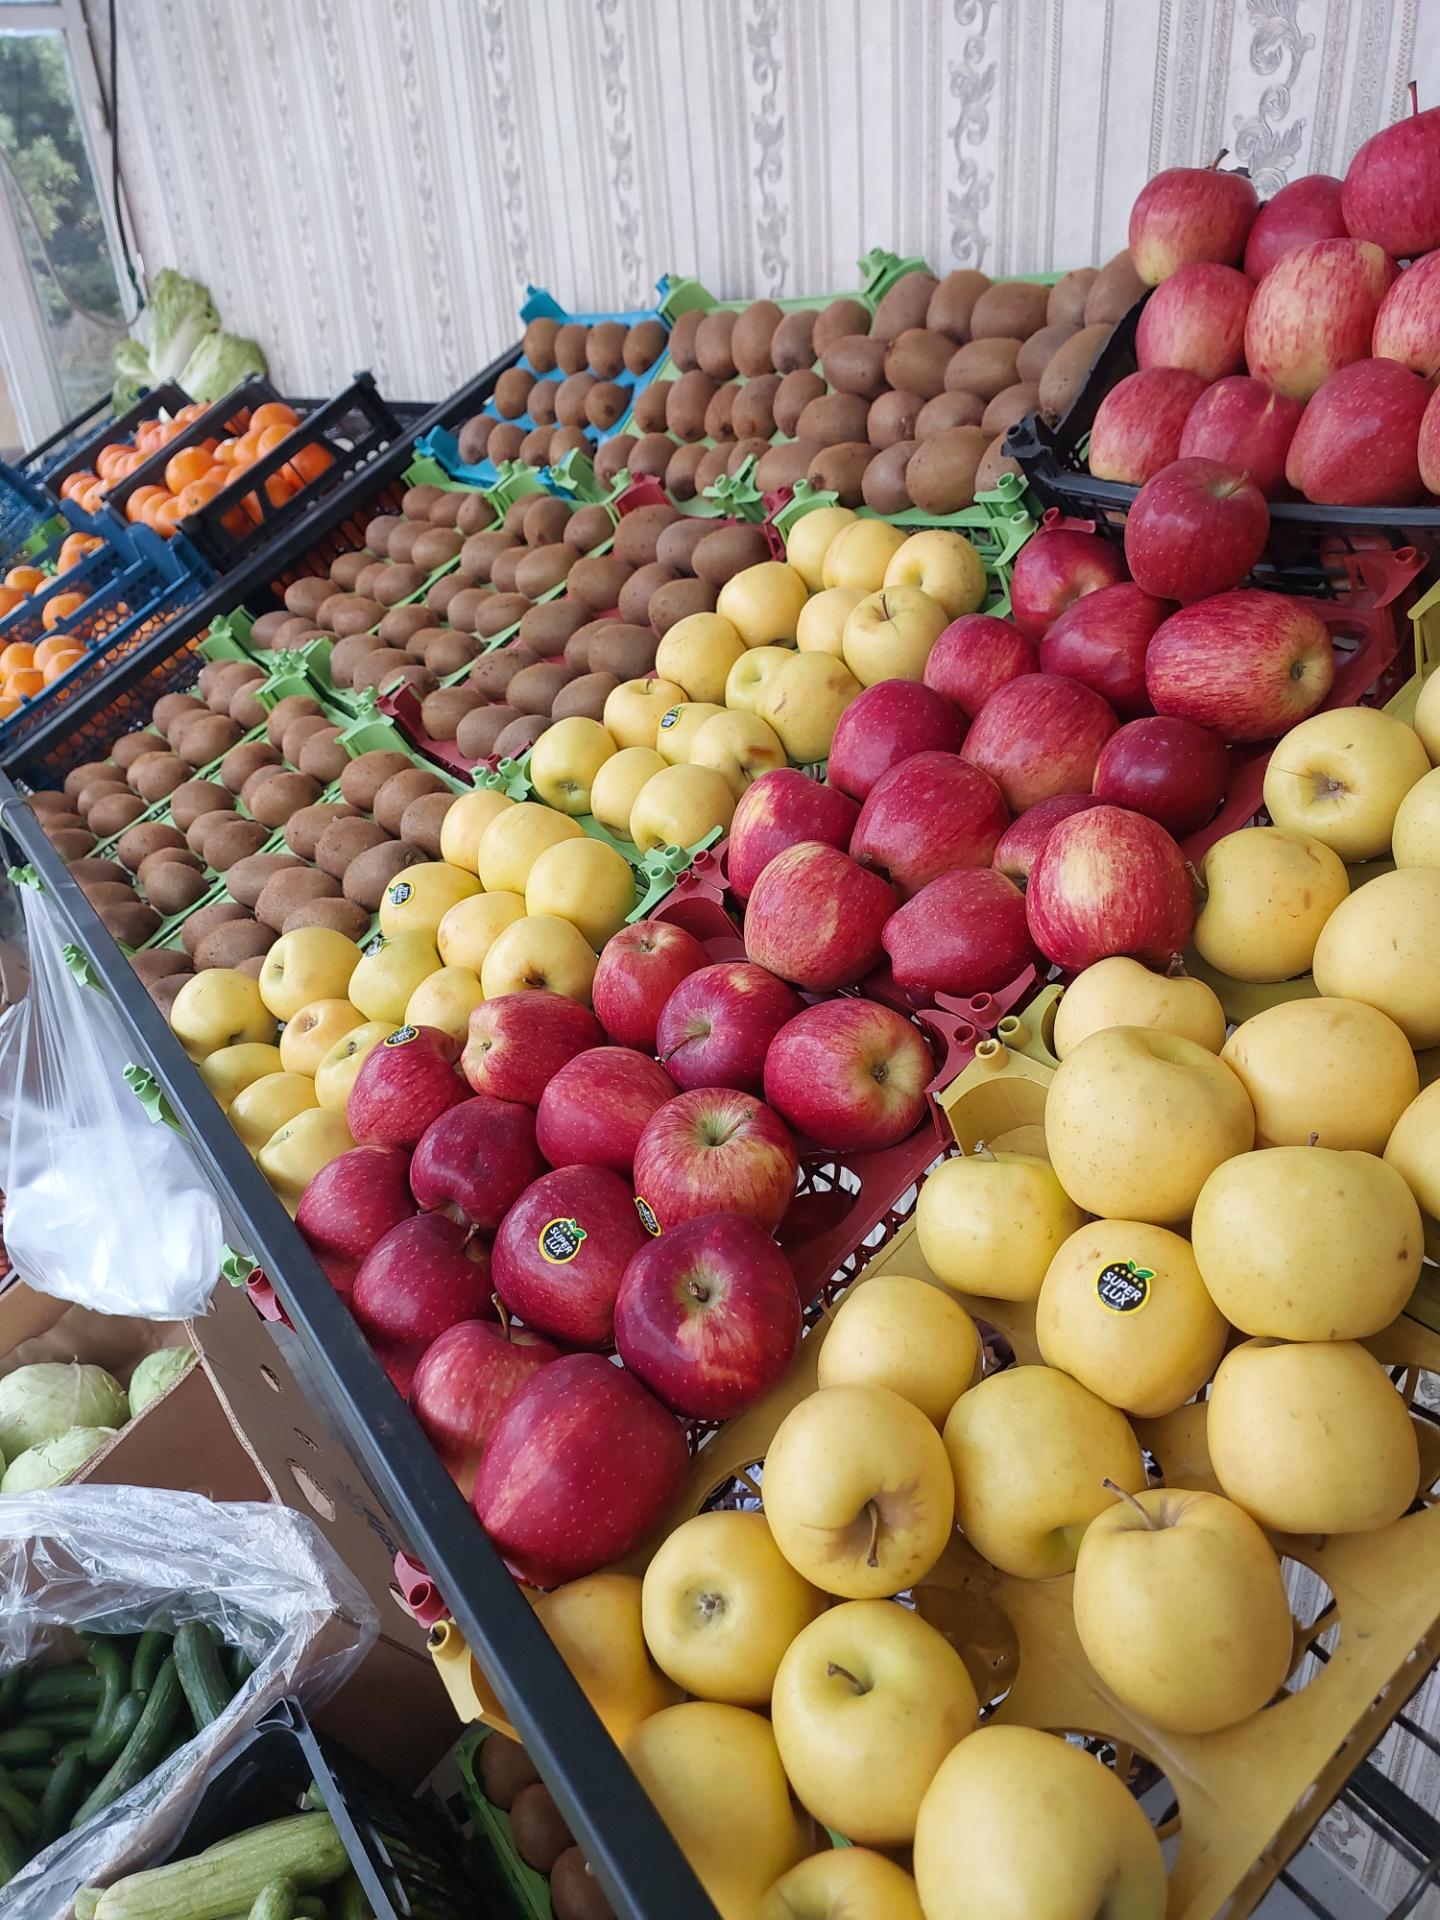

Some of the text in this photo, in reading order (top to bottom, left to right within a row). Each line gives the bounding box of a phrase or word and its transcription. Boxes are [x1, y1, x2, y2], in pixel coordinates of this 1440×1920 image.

[546, 1237, 564, 1256] LUX
[549, 1226, 573, 1254] SUPER
[1102, 1271, 1142, 1302] SUPER
[1102, 1284, 1130, 1306] LUX
